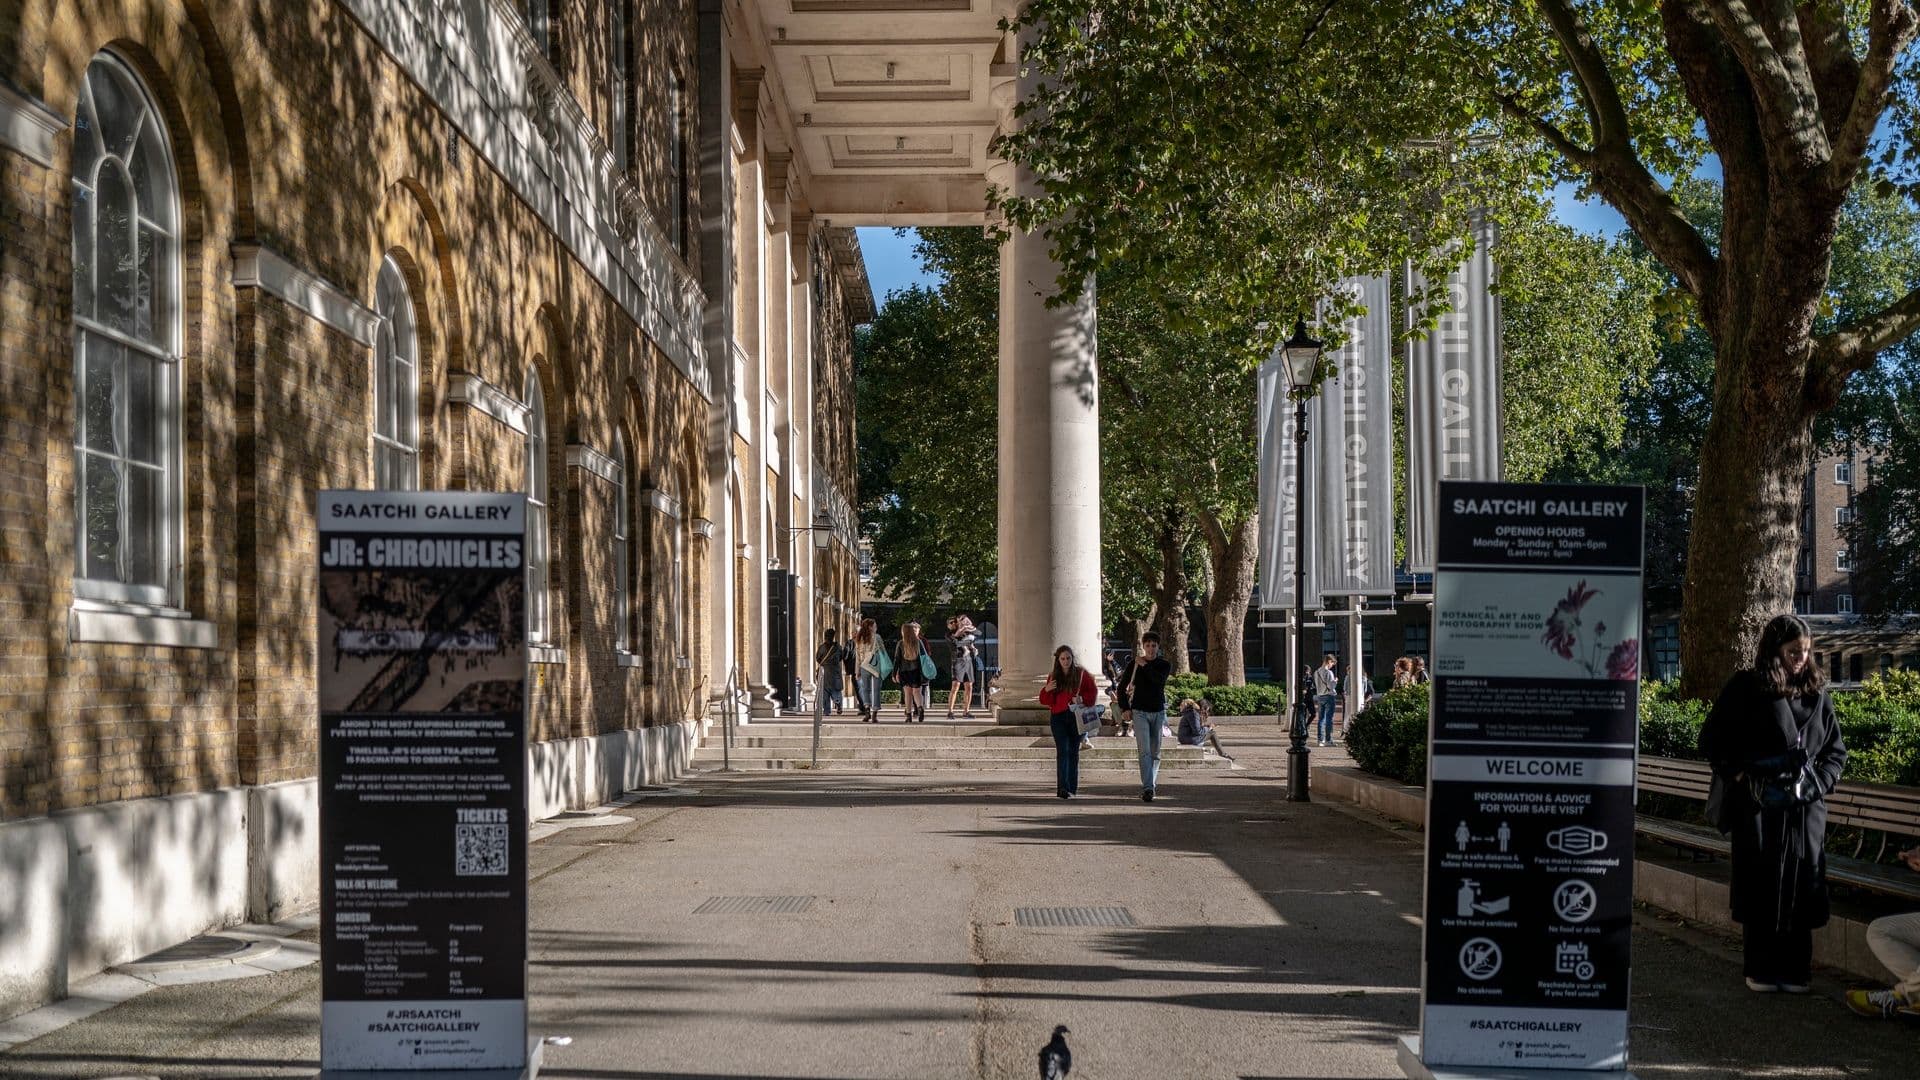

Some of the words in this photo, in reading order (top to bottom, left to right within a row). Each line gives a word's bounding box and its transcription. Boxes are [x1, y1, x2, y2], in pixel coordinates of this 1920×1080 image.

[331, 504, 416, 518] SAATCHI
[425, 505, 511, 520] GALLERY
[1345, 433, 1369, 584] GALLERY
[1453, 499, 1536, 515] SAATCHI
[1543, 501, 1628, 517] GALLERY
[1495, 526, 1544, 537] OPENING
[1547, 527, 1585, 538] HOURS
[1473, 538, 1509, 549] Monday
[1518, 539, 1554, 549] Sunday:
[322, 538, 364, 567] JR:
[367, 538, 521, 568] CHRONICLES
[1507, 549, 1527, 558] (Last
[1528, 549, 1550, 559] Entry:
[1442, 612, 1495, 620] BOTANICAL
[1521, 613, 1541, 621] AND
[1439, 621, 1511, 629] PHOTOGRAPHY
[1514, 622, 1544, 630] SHOW
[1486, 760, 1584, 776] WELCOME
[1474, 792, 1543, 802] INFORMATION
[1545, 794, 1553, 803] &
[1554, 794, 1591, 804] ADVICE
[1480, 804, 1500, 813] FOR
[1502, 804, 1530, 813] YOUR
[1531, 805, 1557, 814] SAFE
[1559, 806, 1585, 815] VISIT
[456, 809, 508, 823] TICKETS
[1534, 857, 1553, 865] Face
[1574, 858, 1619, 867] recommended
[1572, 867, 1607, 875] mandatory
[1538, 981, 1575, 989] Reschedule
[387, 1009, 461, 1019] #JRSAATCHI
[368, 1022, 480, 1033] #SAATCHIGALLERY
[1470, 1020, 1582, 1033] #SAATCHIGALLERY
